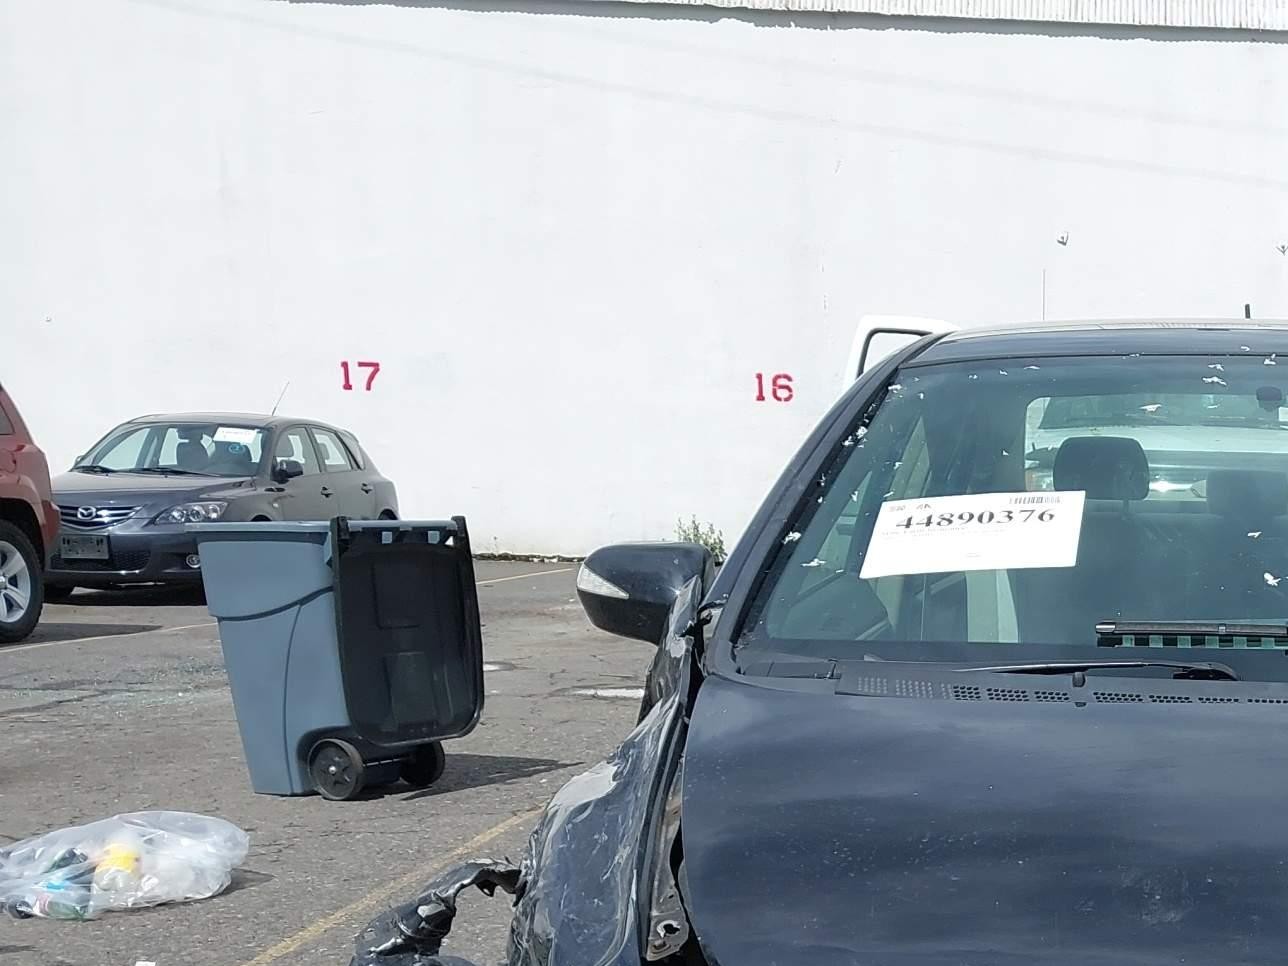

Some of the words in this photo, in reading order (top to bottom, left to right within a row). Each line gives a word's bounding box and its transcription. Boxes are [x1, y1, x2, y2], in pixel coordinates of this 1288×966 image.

[340, 361, 380, 391] 17
[755, 372, 793, 402] 16
[895, 508, 1056, 529] 44890376
